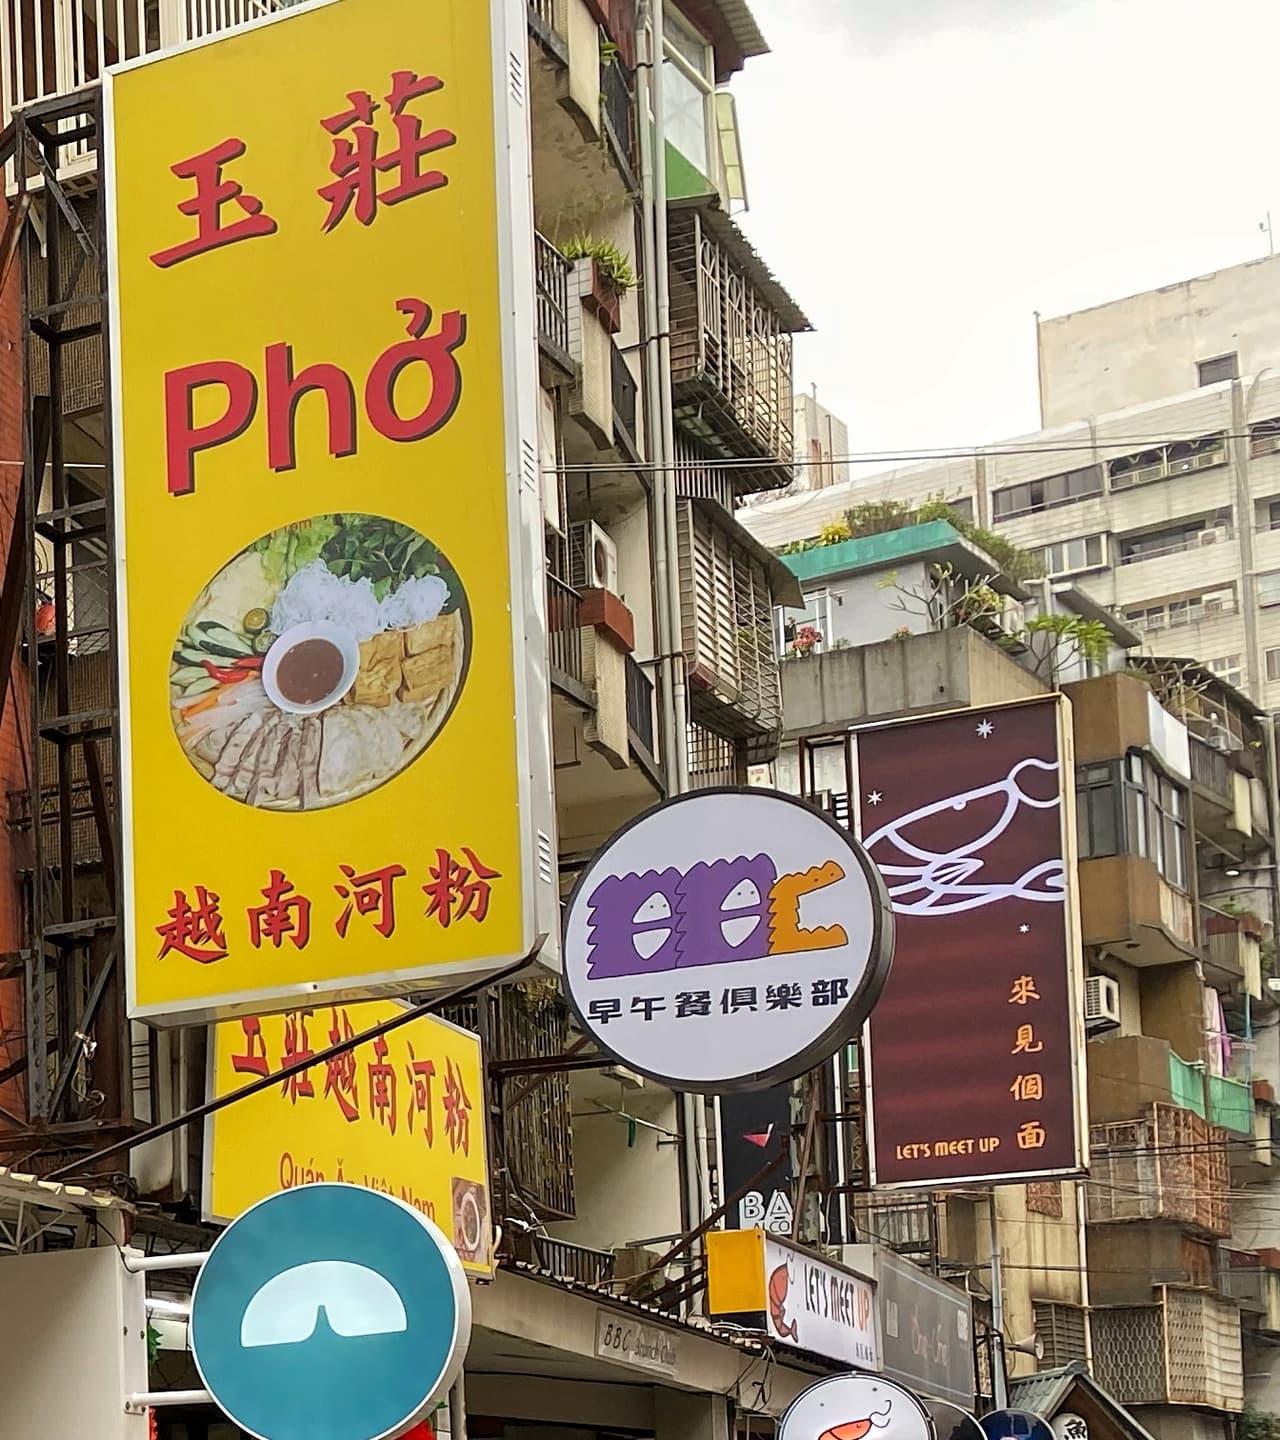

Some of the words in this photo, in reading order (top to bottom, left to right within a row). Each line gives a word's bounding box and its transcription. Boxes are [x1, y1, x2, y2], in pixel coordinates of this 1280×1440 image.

[149, 70, 458, 269] 玉莊
[164, 297, 467, 497] Phở
[155, 847, 503, 964] 越南河粉
[586, 977, 850, 1026] 早午餐俱樂部
[1007, 974, 1047, 1151] 來見個面
[896, 1143, 931, 1160] LET'S
[934, 1138, 975, 1157] MEET
[978, 1136, 1001, 1153] UP
[603, 1323, 632, 1352] BBC
[804, 1263, 828, 1318] LET'S
[830, 1275, 855, 1329] MEET
[856, 1286, 870, 1333] UP
